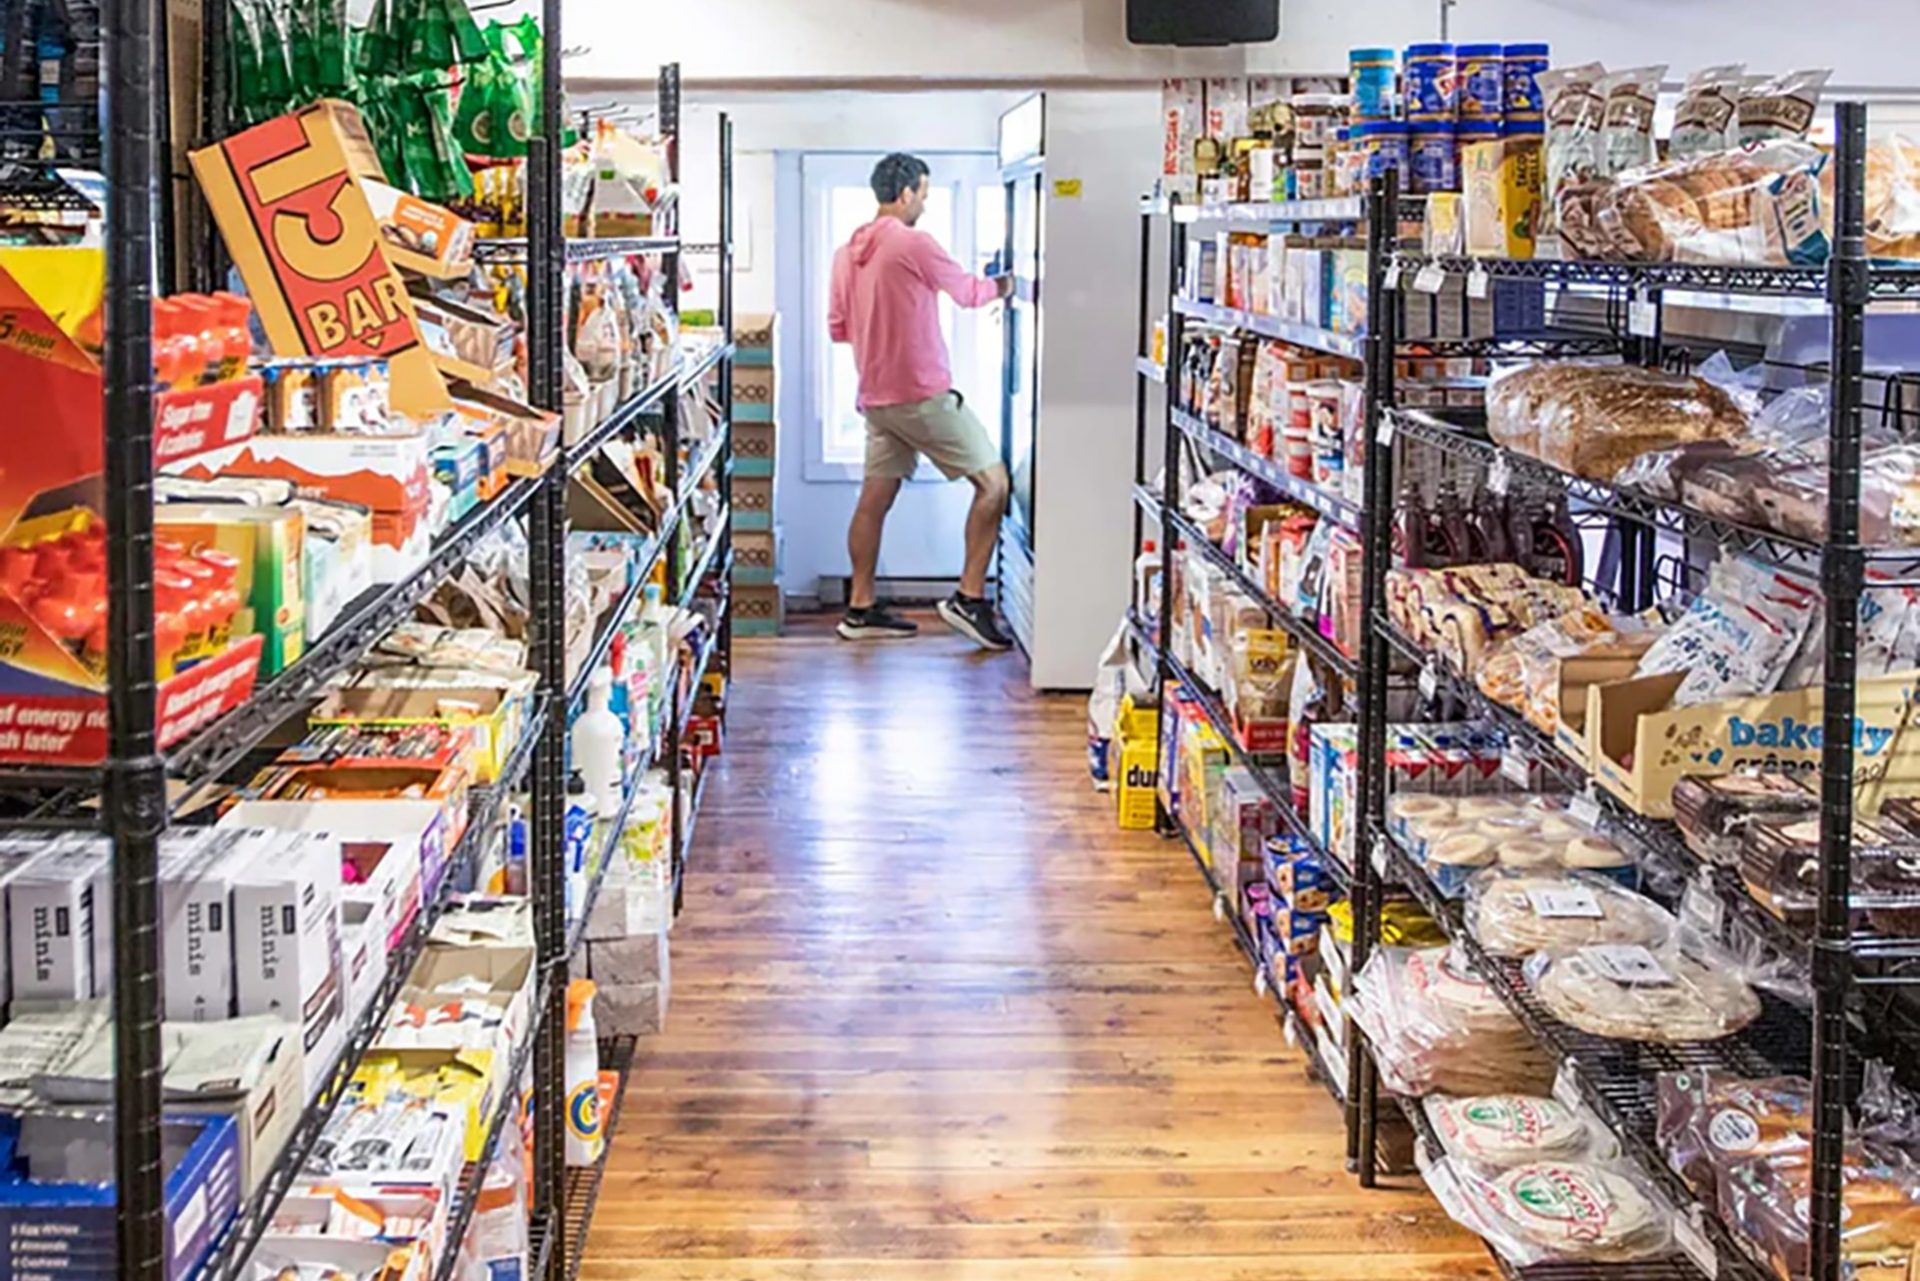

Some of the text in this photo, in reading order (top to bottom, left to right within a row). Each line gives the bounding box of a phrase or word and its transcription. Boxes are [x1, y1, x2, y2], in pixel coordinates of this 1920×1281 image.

[1515, 154, 1528, 188] TACO
[306, 275, 410, 351] BAR
[17, 708, 84, 732] energy
[1728, 715, 1893, 756] bakely
[23, 729, 73, 753] later
[1732, 752, 1825, 775] crêpe
[34, 906, 54, 981] minis
[186, 903, 205, 975] minis
[260, 905, 280, 980] minis
